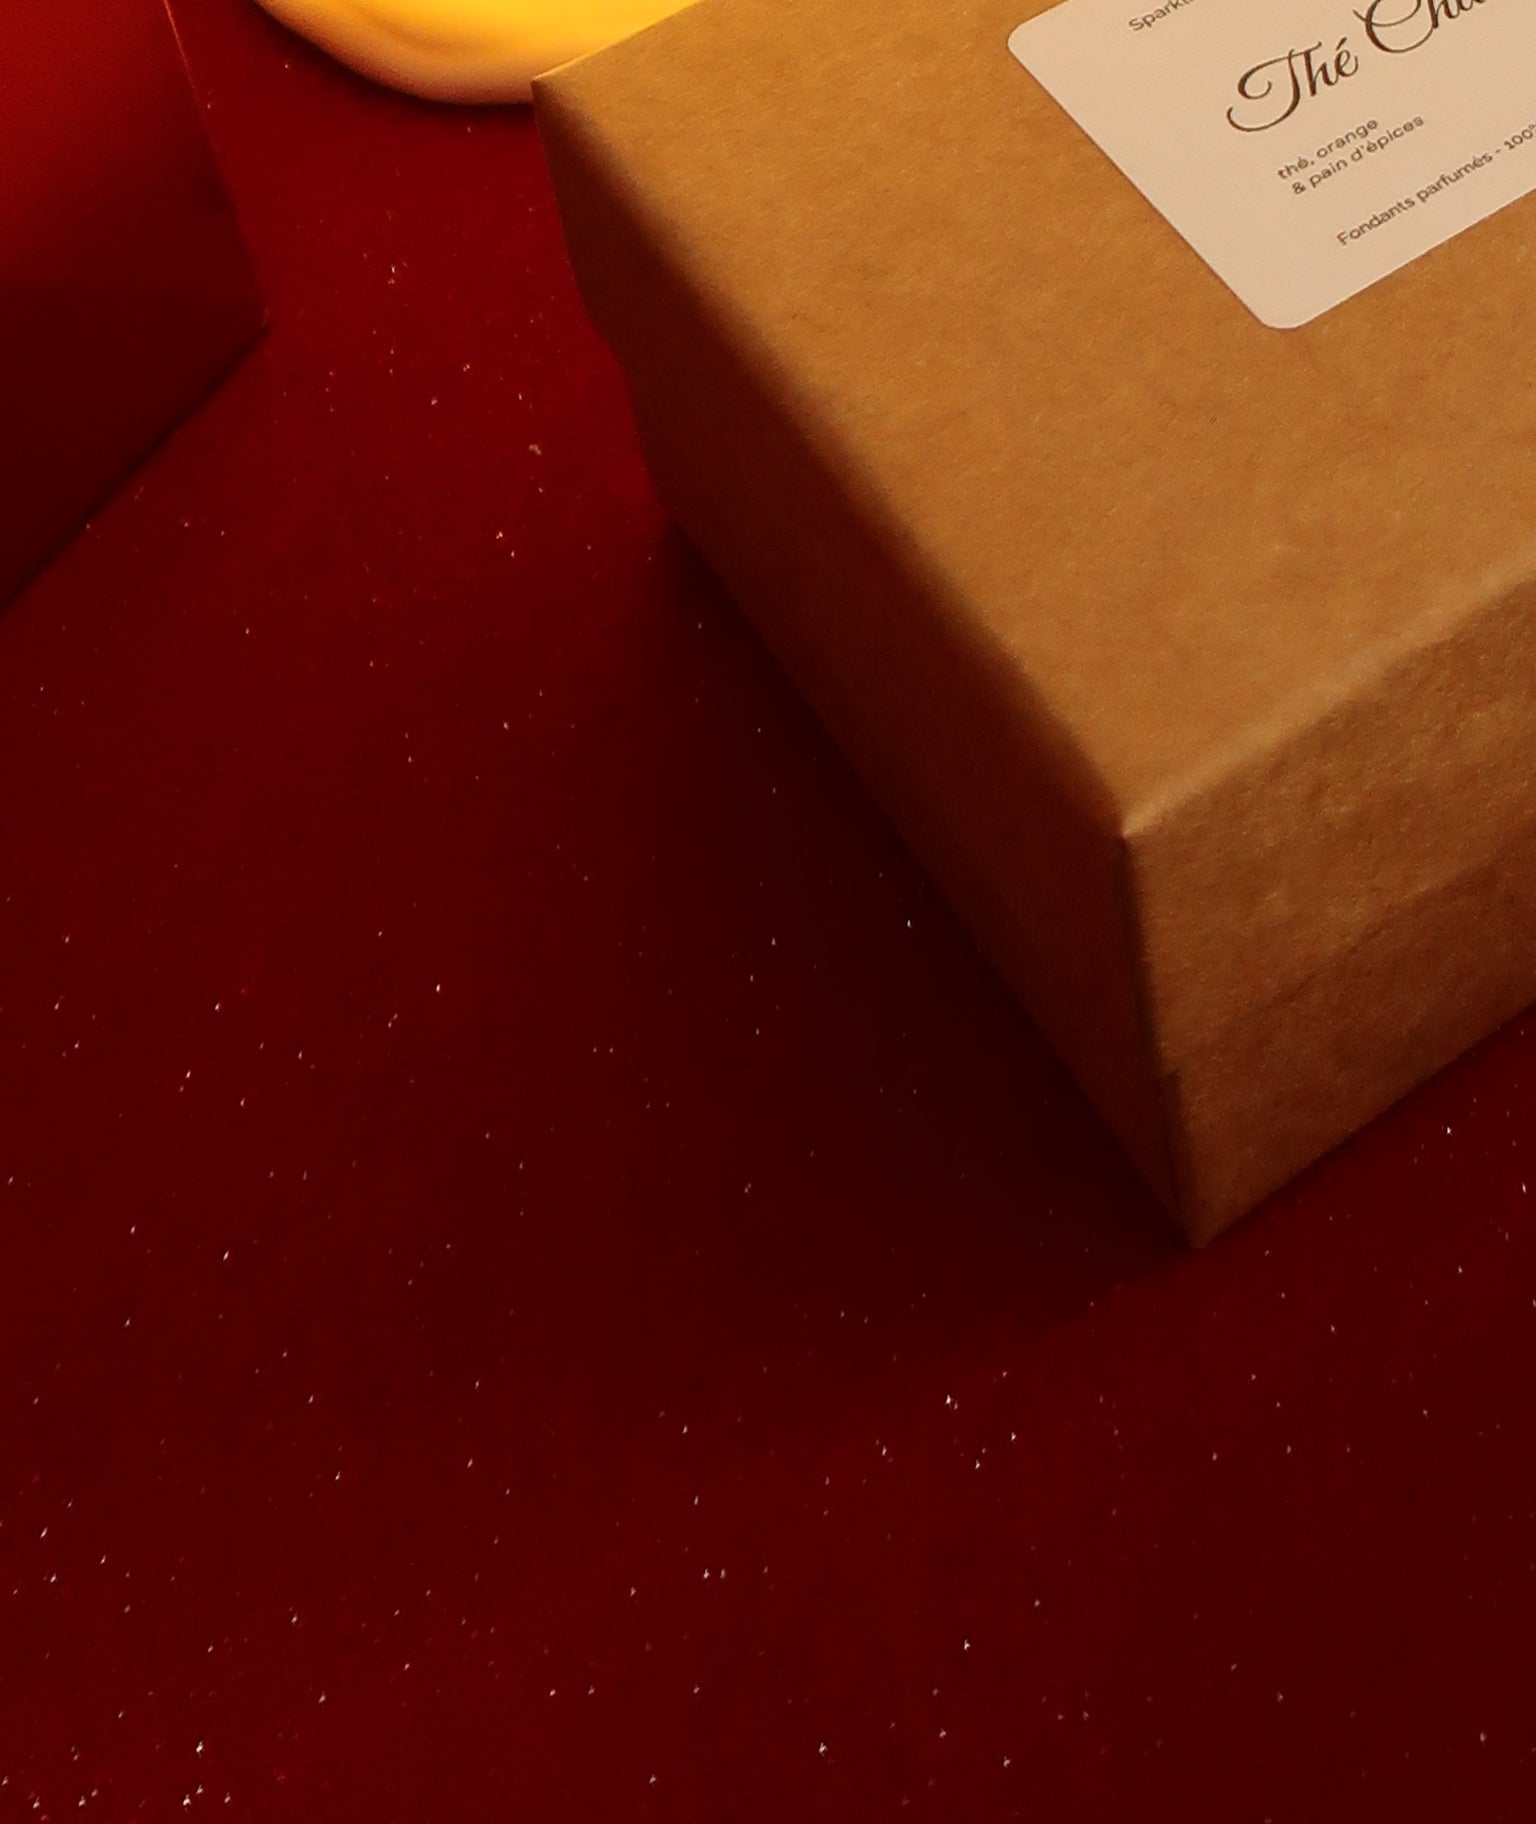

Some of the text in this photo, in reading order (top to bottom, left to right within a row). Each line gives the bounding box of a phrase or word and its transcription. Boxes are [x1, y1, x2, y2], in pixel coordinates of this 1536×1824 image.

[1226, 37, 1360, 132] Thé
[1316, 119, 1379, 159] orange
[1291, 181, 1307, 195] &
[1308, 158, 1349, 189] pain
[1335, 199, 1416, 247] Fondants
[1414, 150, 1494, 204] parfumés
